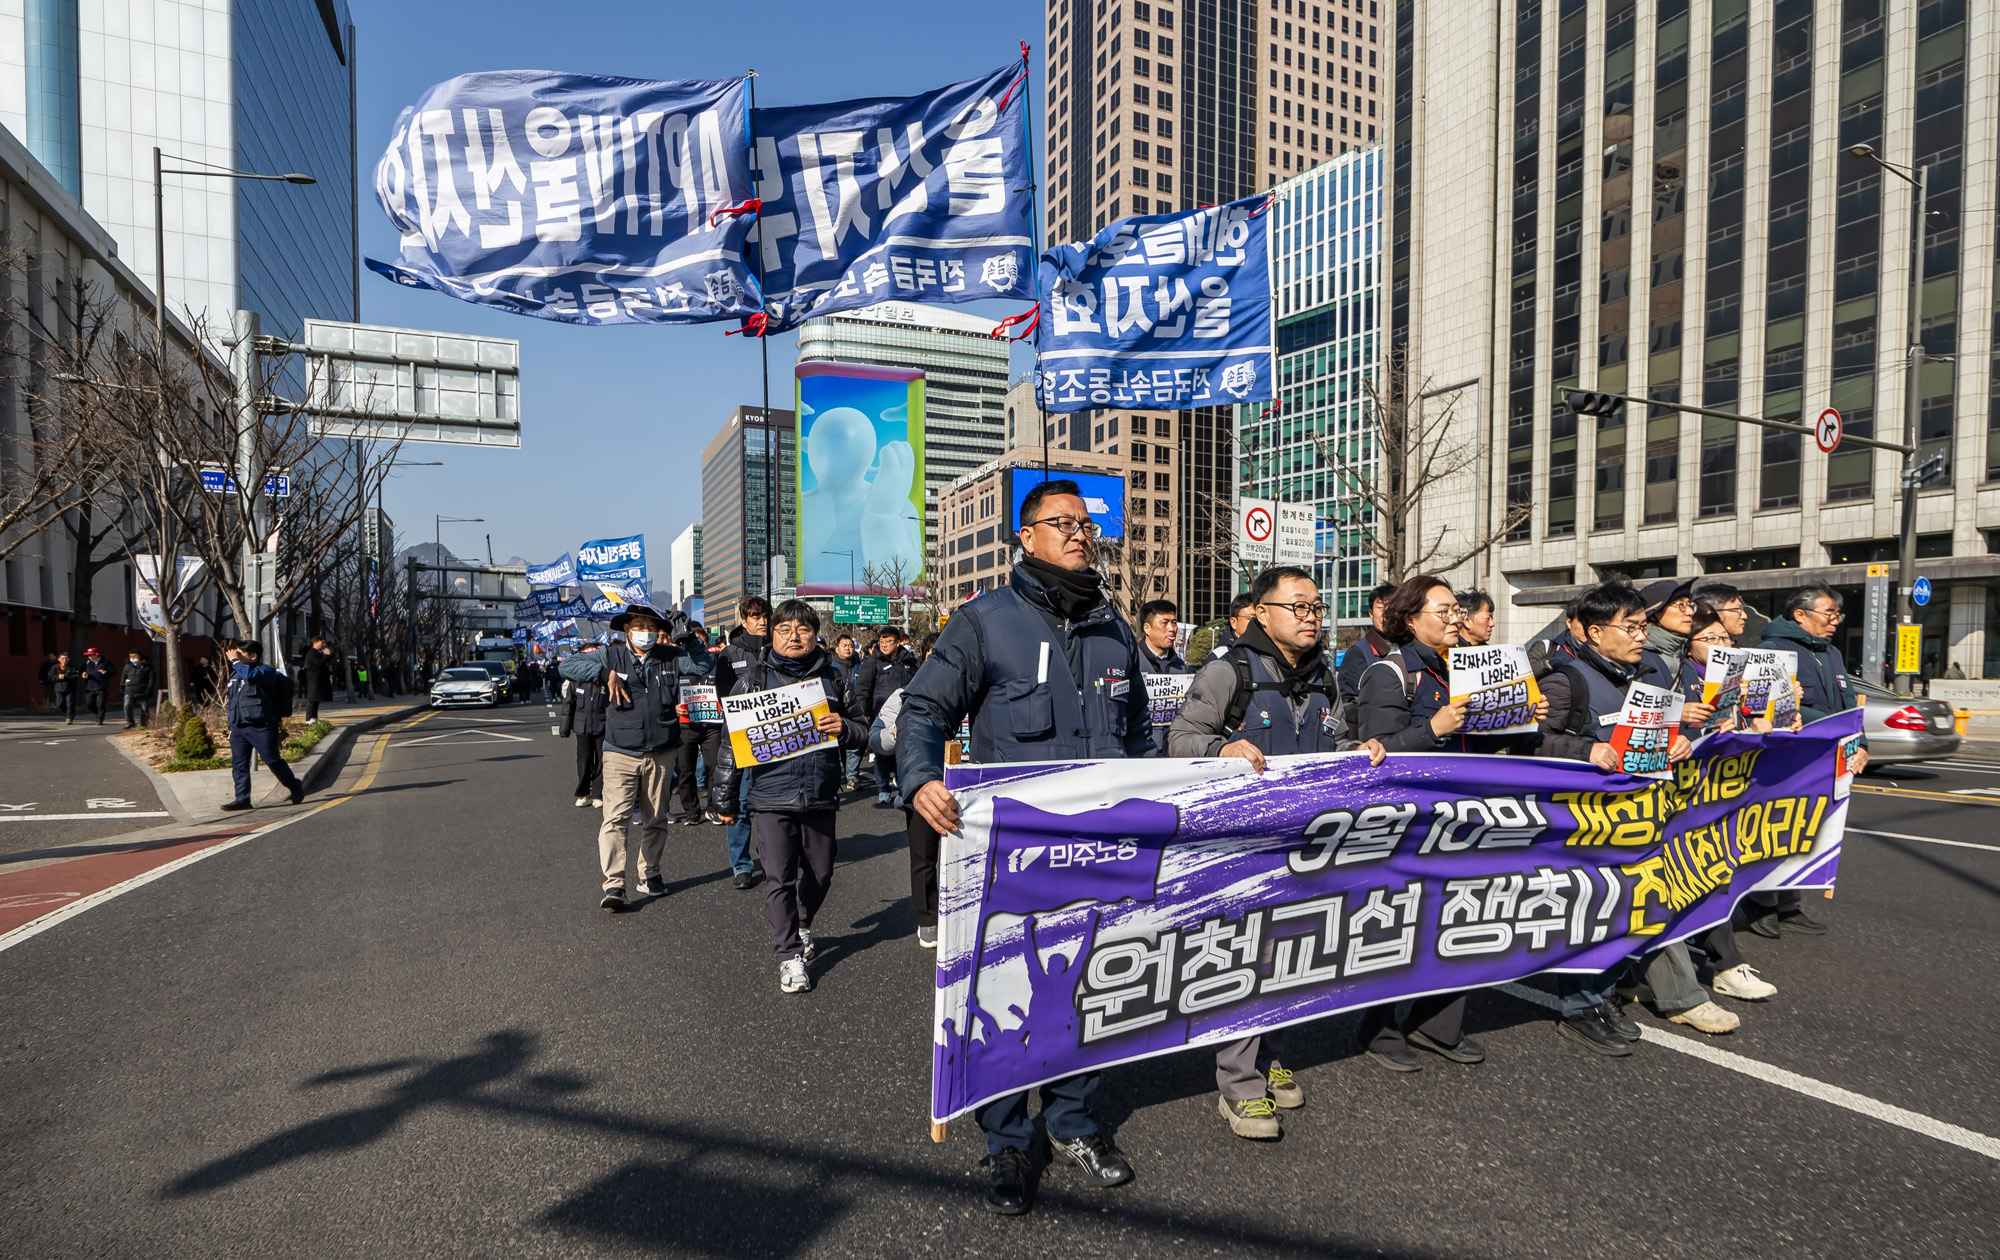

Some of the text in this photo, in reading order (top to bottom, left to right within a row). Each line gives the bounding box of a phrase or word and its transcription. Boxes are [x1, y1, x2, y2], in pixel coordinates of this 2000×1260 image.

[745, 414, 770, 423] KYOB
[1453, 649, 1502, 671] 진짜사장
[1481, 660, 1520, 686] 나와라!
[726, 692, 777, 714] 진짜사장
[1154, 684, 1184, 697] 나와라!
[1468, 681, 1528, 712] 원청교섭
[1629, 690, 1654, 709] 모든
[755, 697, 801, 723] 나와라!
[746, 711, 814, 745] 원청교섭
[1290, 803, 1417, 873] 3월
[1419, 794, 1548, 855] 10일
[1049, 837, 1138, 868] 민주노총
[1081, 882, 1424, 1045] 원청교섭
[1436, 865, 1622, 956] 쟁취!
